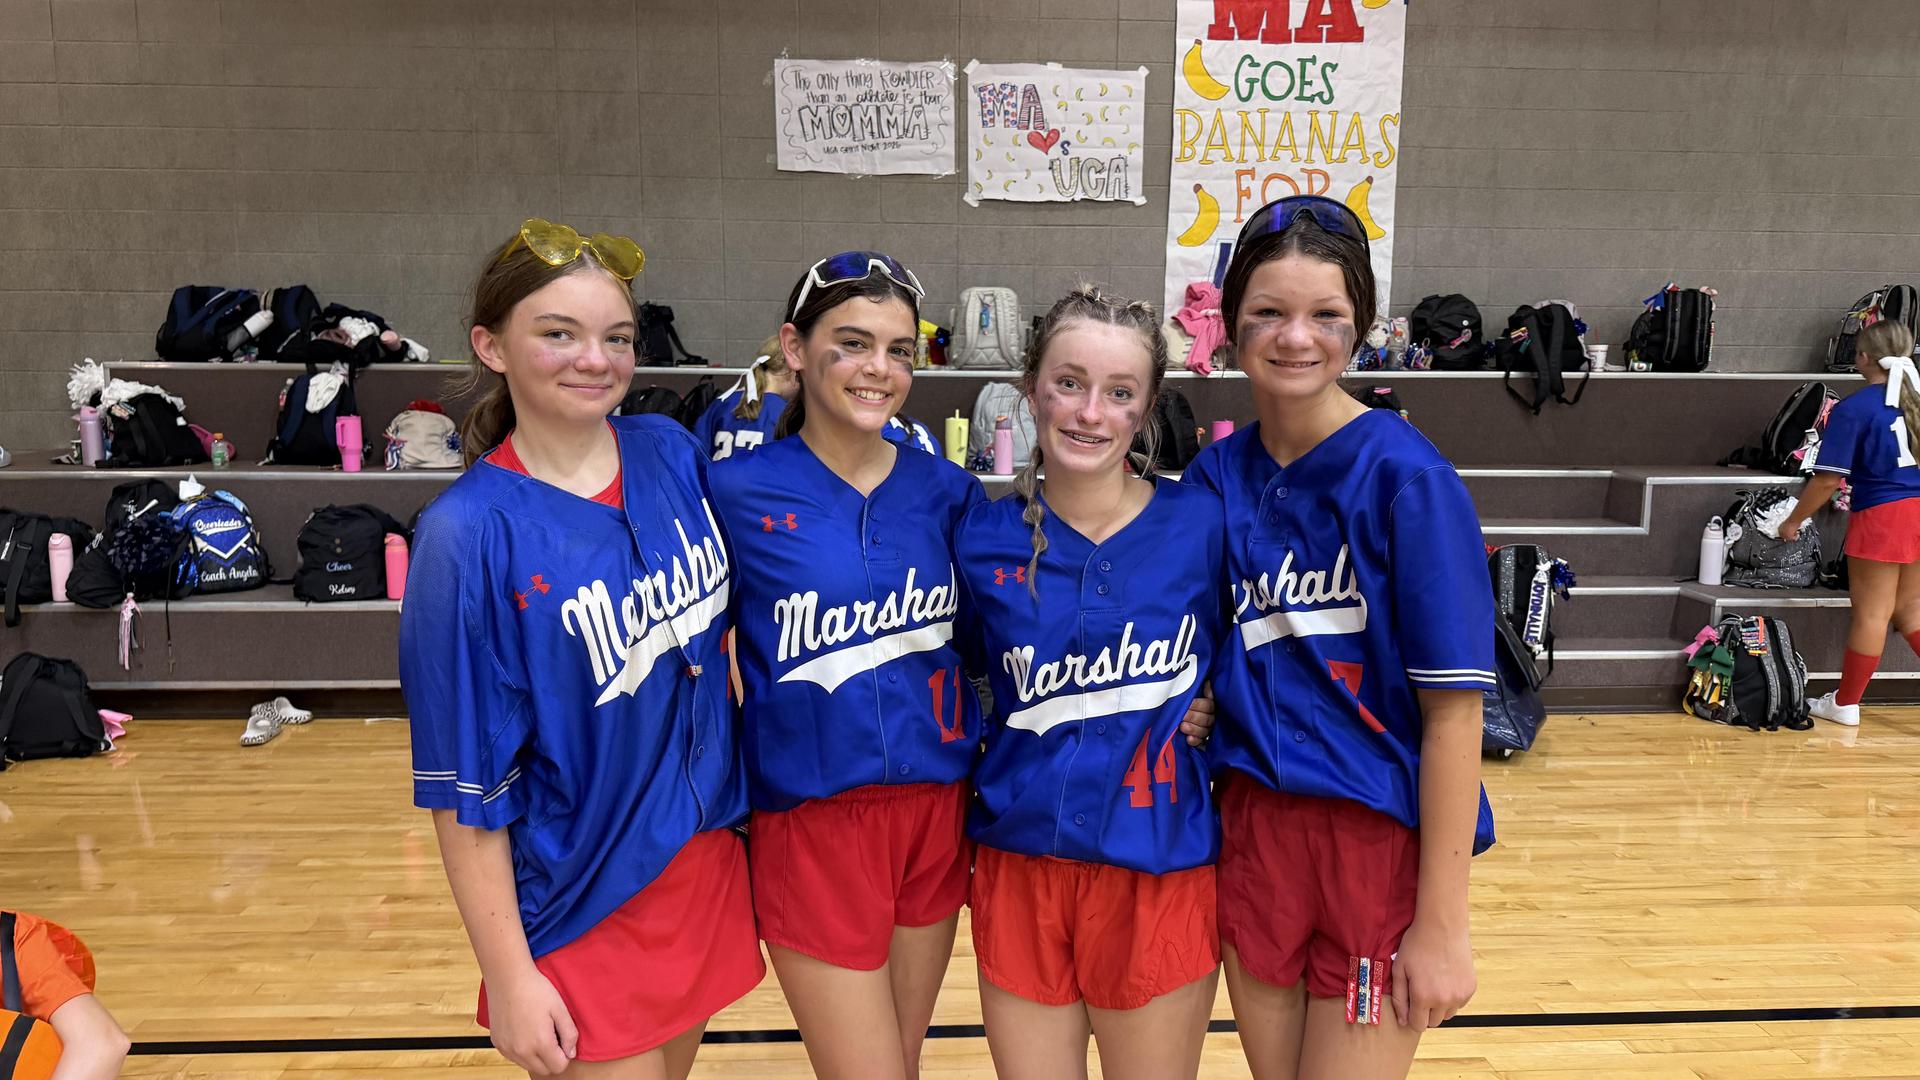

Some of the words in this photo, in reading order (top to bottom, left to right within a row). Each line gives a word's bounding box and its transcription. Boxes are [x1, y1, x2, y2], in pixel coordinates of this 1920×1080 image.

[1207, 0, 1365, 44] MA
[817, 70, 840, 91] only
[846, 69, 873, 90] thing
[880, 69, 935, 90] ROWDIER
[1234, 54, 1338, 104] GOES
[798, 104, 930, 142] MOMMA
[977, 84, 1047, 131] MA
[1175, 108, 1399, 168] BANANAS
[1051, 156, 1130, 199] UCA
[201, 567, 226, 582] Coach
[561, 498, 730, 686] Marshal
[1231, 543, 1362, 616] rshall
[1003, 614, 1197, 702] Marshall
[1121, 727, 1178, 808] 44
